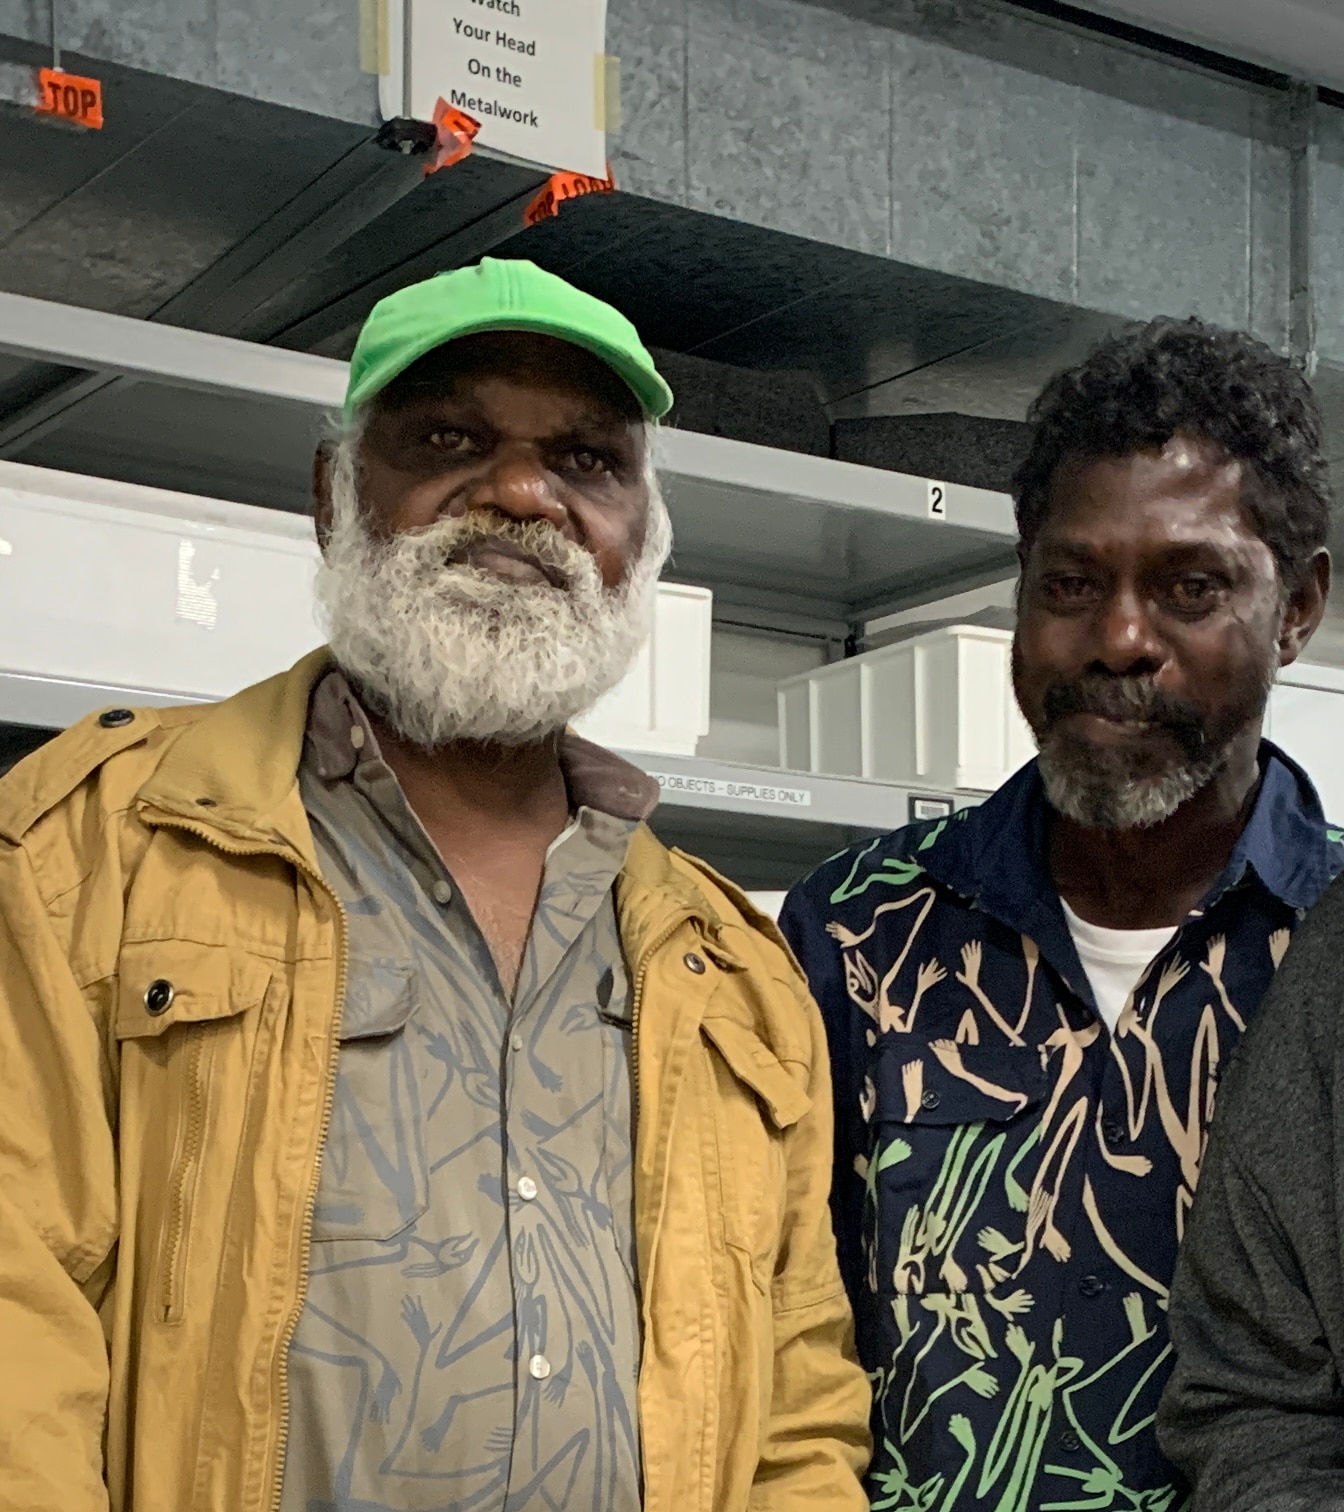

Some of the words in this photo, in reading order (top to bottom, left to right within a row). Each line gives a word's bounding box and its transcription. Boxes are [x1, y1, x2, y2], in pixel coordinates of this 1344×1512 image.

[453, 17, 491, 42] Your
[496, 30, 536, 56] Head
[468, 58, 491, 78] On
[496, 66, 522, 88] the
[47, 80, 97, 119] TOP
[451, 89, 539, 128] Metalwork
[931, 486, 943, 514] 2
[668, 776, 716, 793] OBJECTS
[726, 783, 776, 801] SUPPLIES
[777, 790, 805, 804] ONLY
